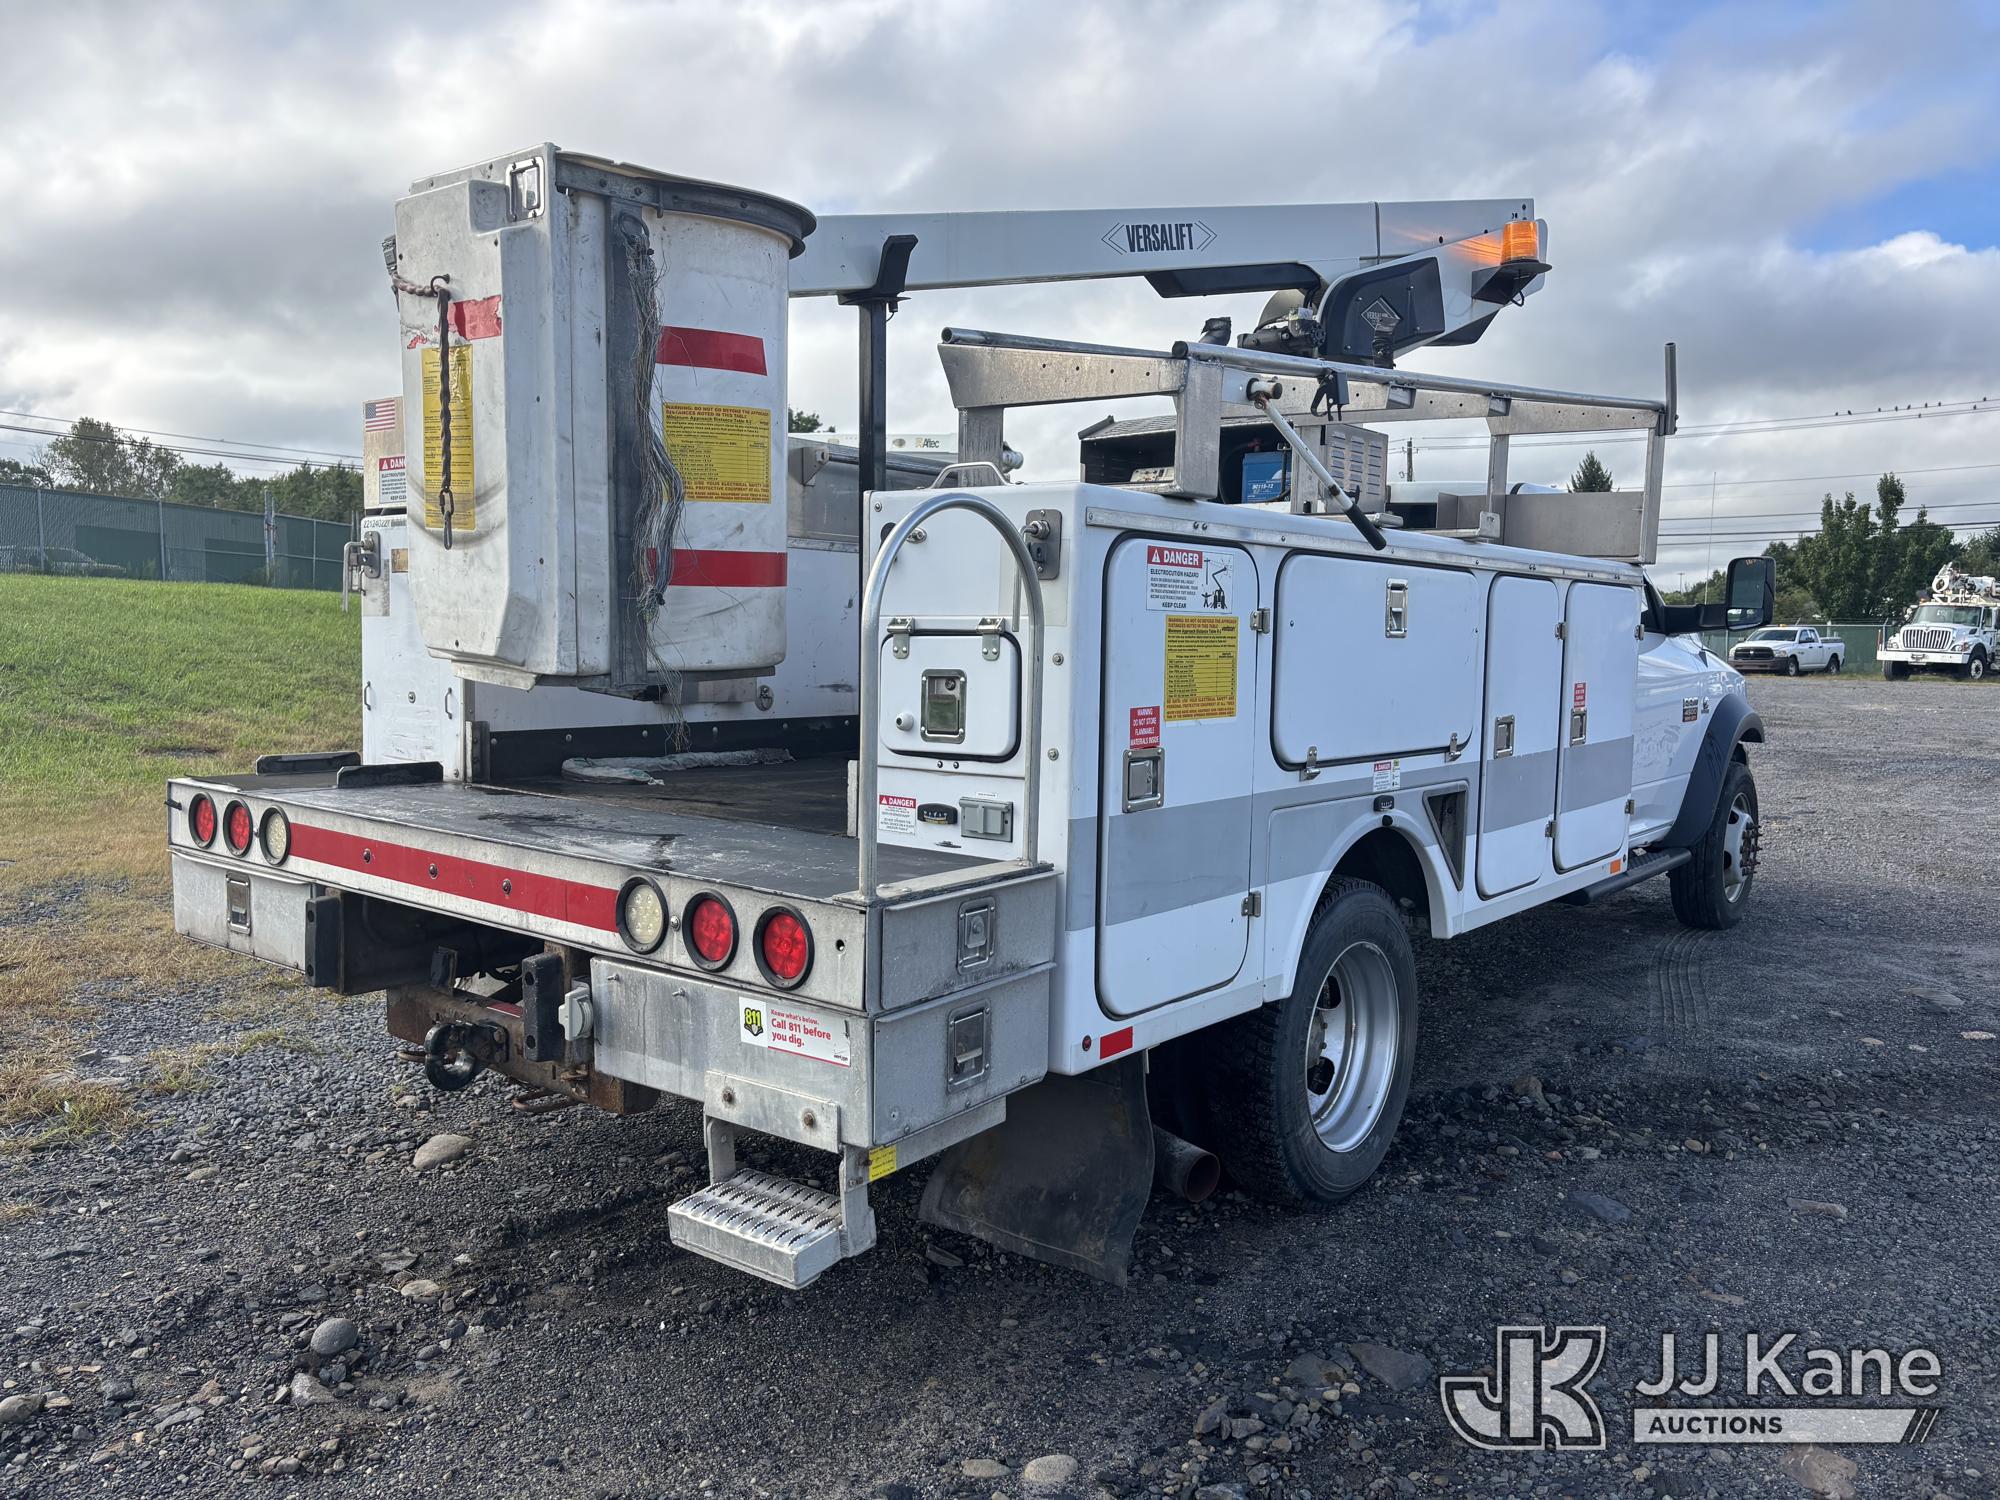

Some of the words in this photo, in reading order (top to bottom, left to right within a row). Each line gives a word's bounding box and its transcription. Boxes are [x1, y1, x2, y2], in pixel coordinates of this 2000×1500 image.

[1126, 223, 1193, 252] VERSALIFT
[1164, 550, 1199, 566] DANGER
[1150, 568, 1183, 577] ELECTROCUTION
[1184, 571, 1199, 579] HAZARD
[1137, 708, 1153, 716] WARNING
[1146, 717, 1157, 725] STORE
[889, 797, 914, 808] DANGER
[745, 1007, 761, 1027] 811
[771, 1009, 784, 1017] Know
[785, 1013, 801, 1021] what's
[802, 1016, 819, 1025] below.
[771, 1018, 786, 1030] Call
[789, 1022, 801, 1033] 811
[803, 1025, 831, 1040] before
[772, 1031, 787, 1041] you
[789, 1034, 805, 1047] dig.
